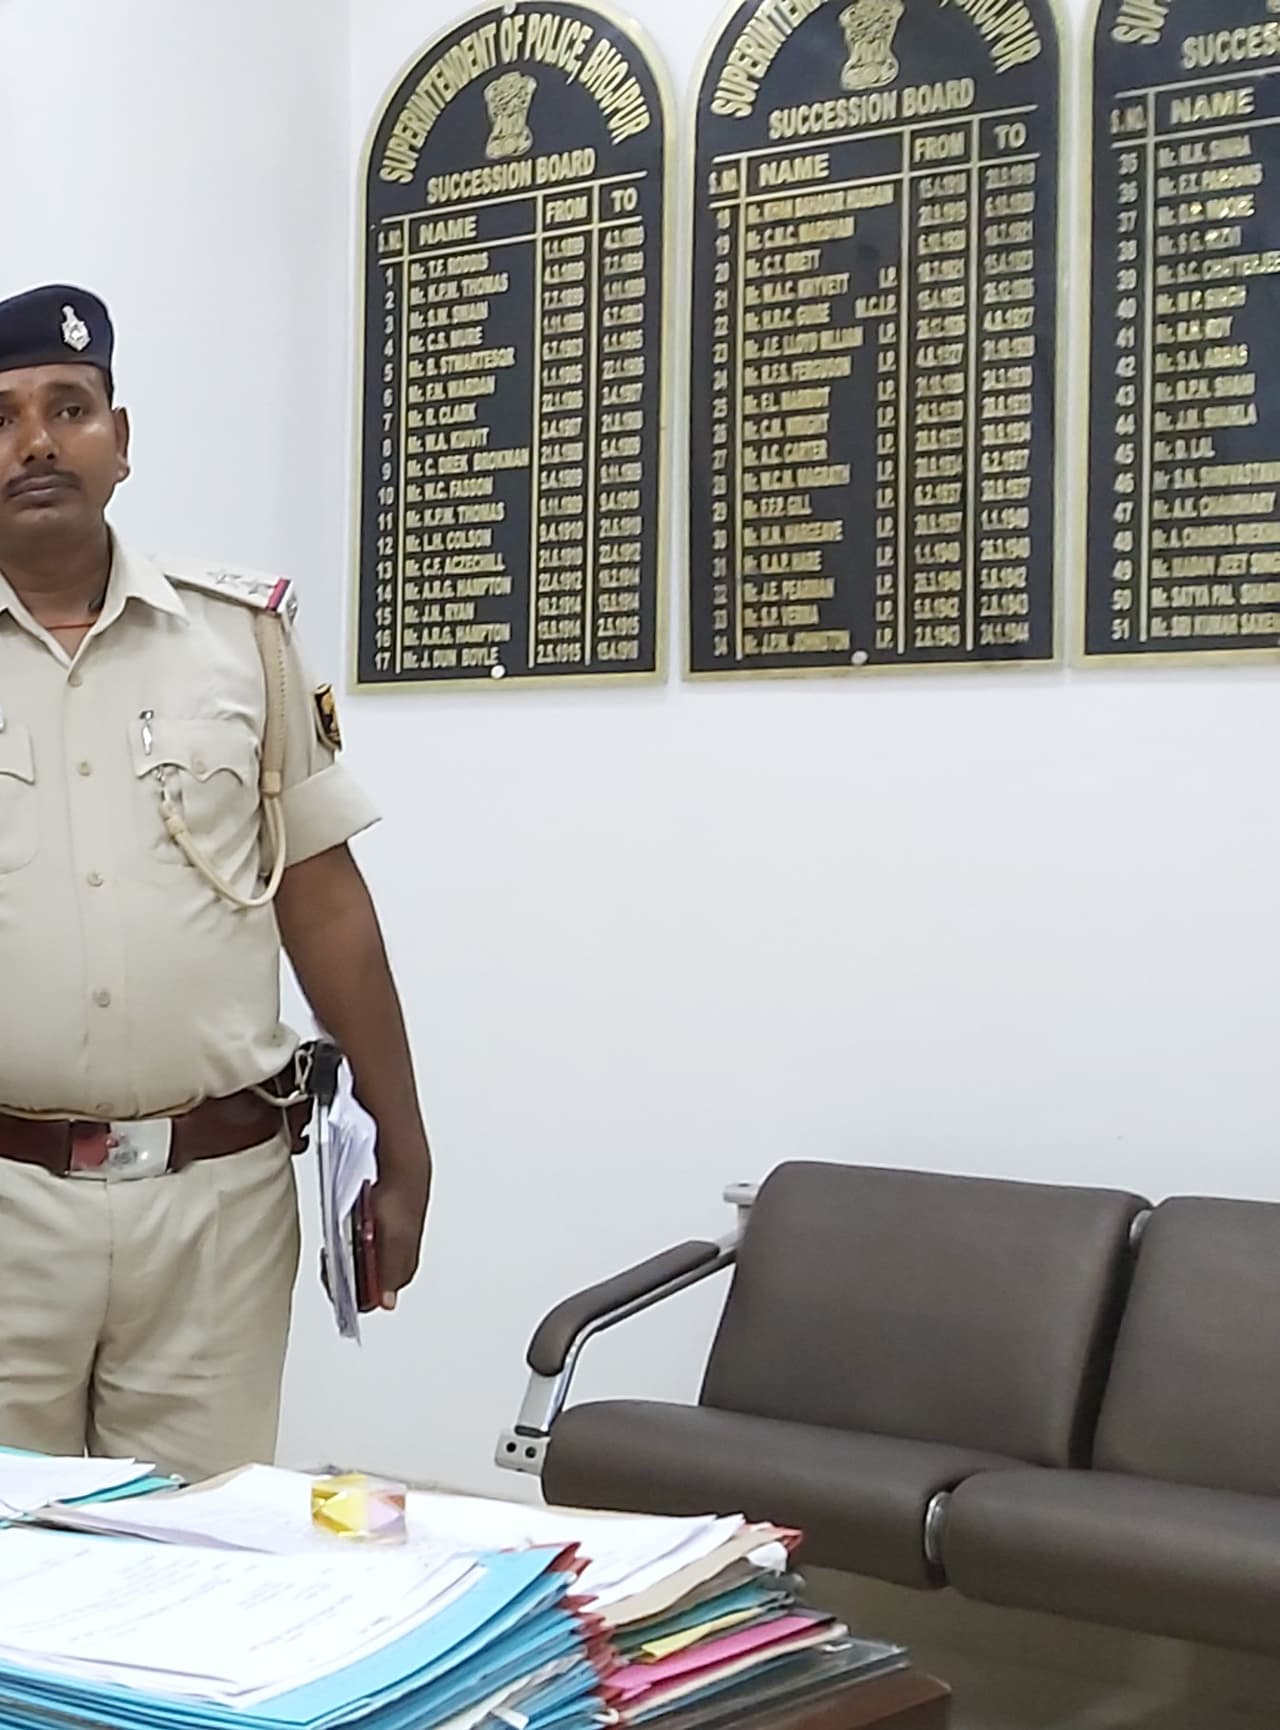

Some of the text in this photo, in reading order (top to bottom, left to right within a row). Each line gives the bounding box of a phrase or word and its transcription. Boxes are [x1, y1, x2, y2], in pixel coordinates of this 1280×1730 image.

[379, 22, 497, 183] SUPERINTENDENT
[500, 15, 526, 64] OF
[579, 38, 651, 145] BHOJPUR
[768, 78, 975, 140] SUCCESSION BOARD
[1171, 86, 1255, 125] NAME
[759, 153, 830, 188] NAME
[913, 131, 965, 162] FROM
[994, 122, 1026, 150] TO
[427, 147, 597, 204] SUCCESSION BOARD
[419, 215, 478, 246] NAME
[545, 196, 588, 224] FROM
[610, 186, 638, 213] TO
[384, 267, 393, 286] 1
[384, 291, 394, 310] 2
[384, 315, 394, 334] 3
[384, 338, 393, 357] 4
[383, 363, 393, 382] 5
[1114, 355, 1136, 377] 42
[383, 388, 393, 407] 6
[382, 412, 393, 432] 7
[1114, 443, 1135, 465] 45
[381, 462, 391, 481] 9
[377, 486, 394, 505] 10
[377, 512, 393, 531] 11
[377, 536, 393, 556] 12
[376, 560, 393, 580] 13
[376, 584, 392, 602] 14
[375, 606, 392, 626] 15
[1111, 618, 1130, 640] 51
[375, 652, 391, 671] 17
